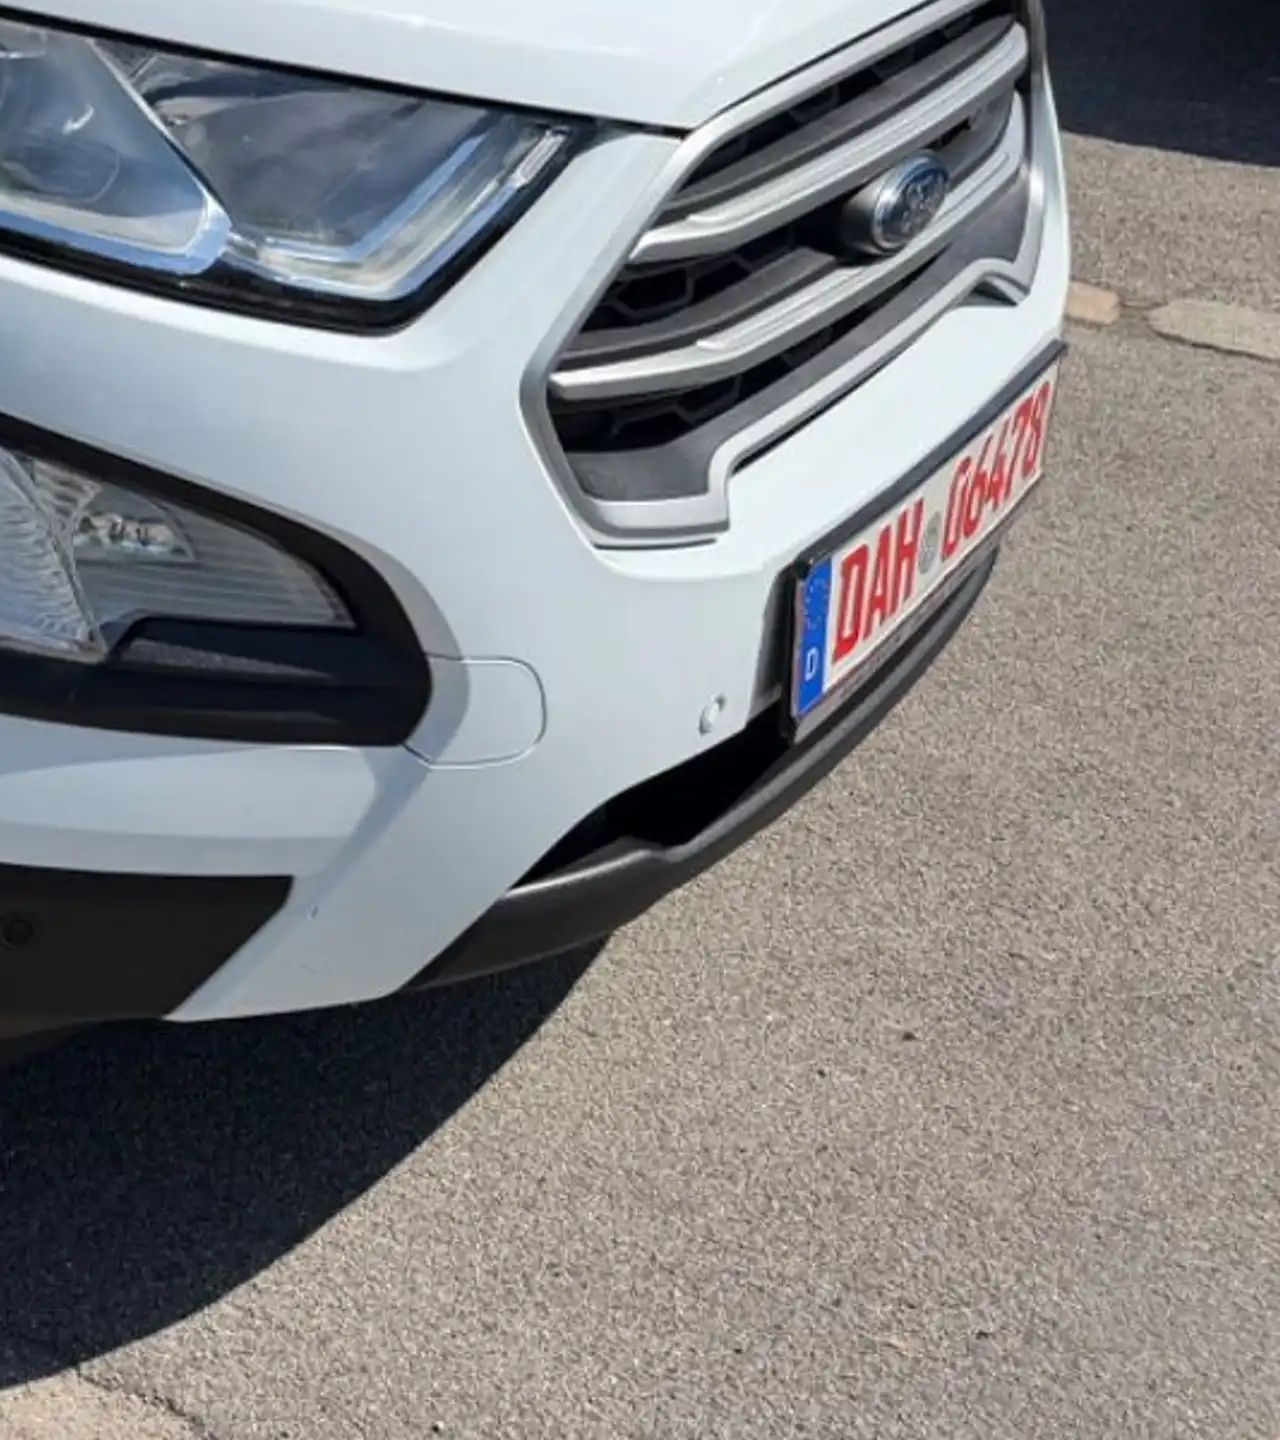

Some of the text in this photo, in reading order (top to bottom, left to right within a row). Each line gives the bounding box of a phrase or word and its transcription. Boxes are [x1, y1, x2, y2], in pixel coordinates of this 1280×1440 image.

[832, 386, 1051, 664] DAH 06478
[804, 646, 818, 682] D
